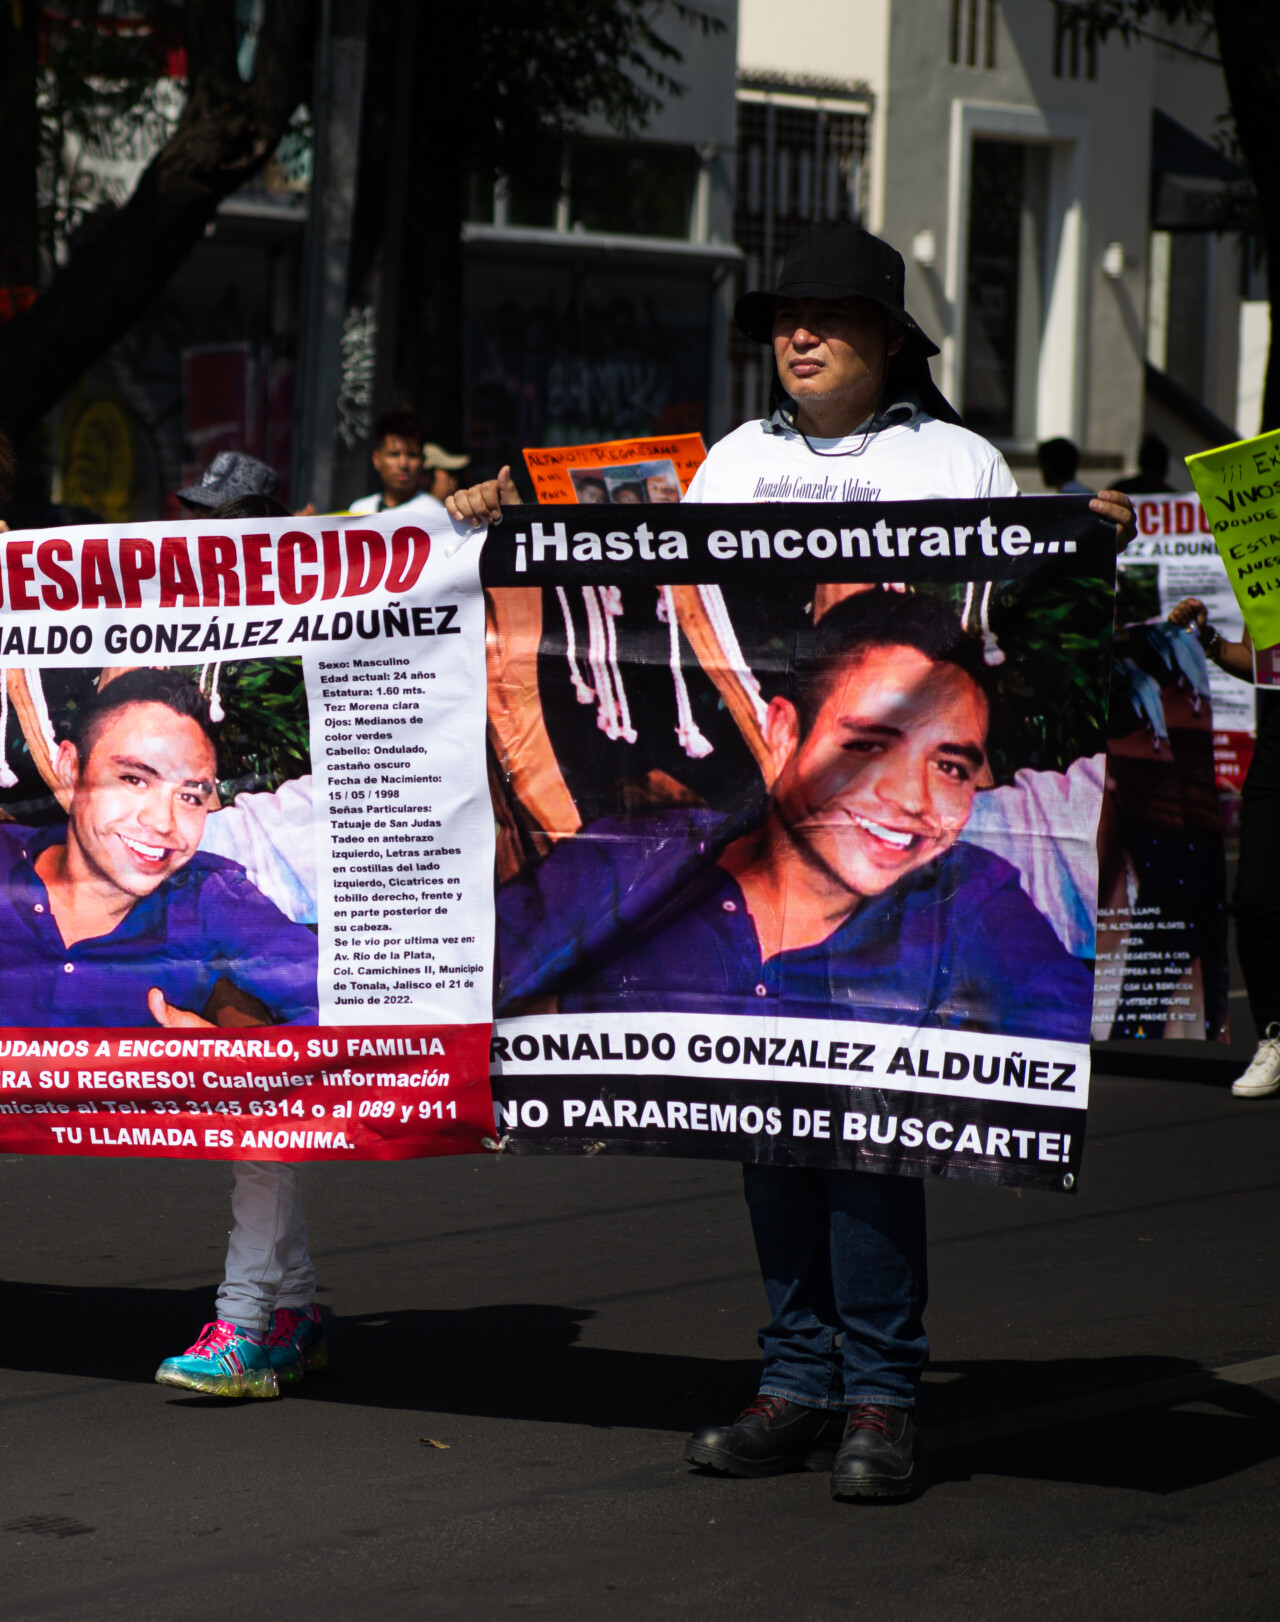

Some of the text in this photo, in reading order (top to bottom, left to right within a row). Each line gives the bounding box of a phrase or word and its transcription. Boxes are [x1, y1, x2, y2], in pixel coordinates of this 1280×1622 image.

[753, 475, 792, 498] Ronaldo
[792, 476, 838, 500] Gonzalez
[1214, 509, 1278, 532] DONDE
[516, 517, 1076, 571] ¡Hasta encontrarte...
[1238, 556, 1280, 579] NUES
[105, 616, 283, 654] GONZÁLEZ
[288, 602, 461, 642] ALDUÑEZ
[335, 938, 348, 946] Se
[352, 938, 361, 946] le
[384, 939, 401, 947] por
[405, 936, 438, 944] ultima
[334, 953, 349, 961] Av.
[353, 952, 370, 960] Rio
[374, 952, 386, 960] de
[404, 951, 435, 960] Plata,
[334, 964, 483, 975] Col. Camichines II, Municipio
[334, 982, 346, 990] de
[350, 982, 389, 991] Tonala,
[393, 981, 432, 989] Jalisco
[435, 980, 445, 988] el
[449, 980, 460, 988] 21
[368, 996, 380, 1004] de
[384, 996, 412, 1004] 2022.
[95, 1041, 110, 1057] A
[118, 1040, 299, 1061] ENCONTRARLO,
[307, 1040, 338, 1057] SU
[347, 1038, 445, 1056] FAMILIA
[490, 1033, 1076, 1093] RONALDO GONZALEZ ALDUÑEZ
[39, 1071, 69, 1088] SU
[78, 1071, 195, 1088] REGRESO!
[203, 1072, 313, 1091] Cualquier
[322, 1069, 449, 1087] información
[78, 1102, 98, 1114] al
[102, 1102, 146, 1114] Tel.
[152, 1101, 180, 1114] 33
[186, 1101, 245, 1119] 3145
[249, 1100, 304, 1117] 6314
[312, 1105, 325, 1117] o
[333, 1101, 352, 1118] al
[359, 1101, 395, 1118] 089
[401, 1106, 413, 1123] y
[419, 1101, 456, 1119] 911
[51, 1127, 354, 1148] TU LLAMADA ES ANONIMA.
[494, 1100, 1072, 1163] NO PARAREMOS DE BUSCARTE!
